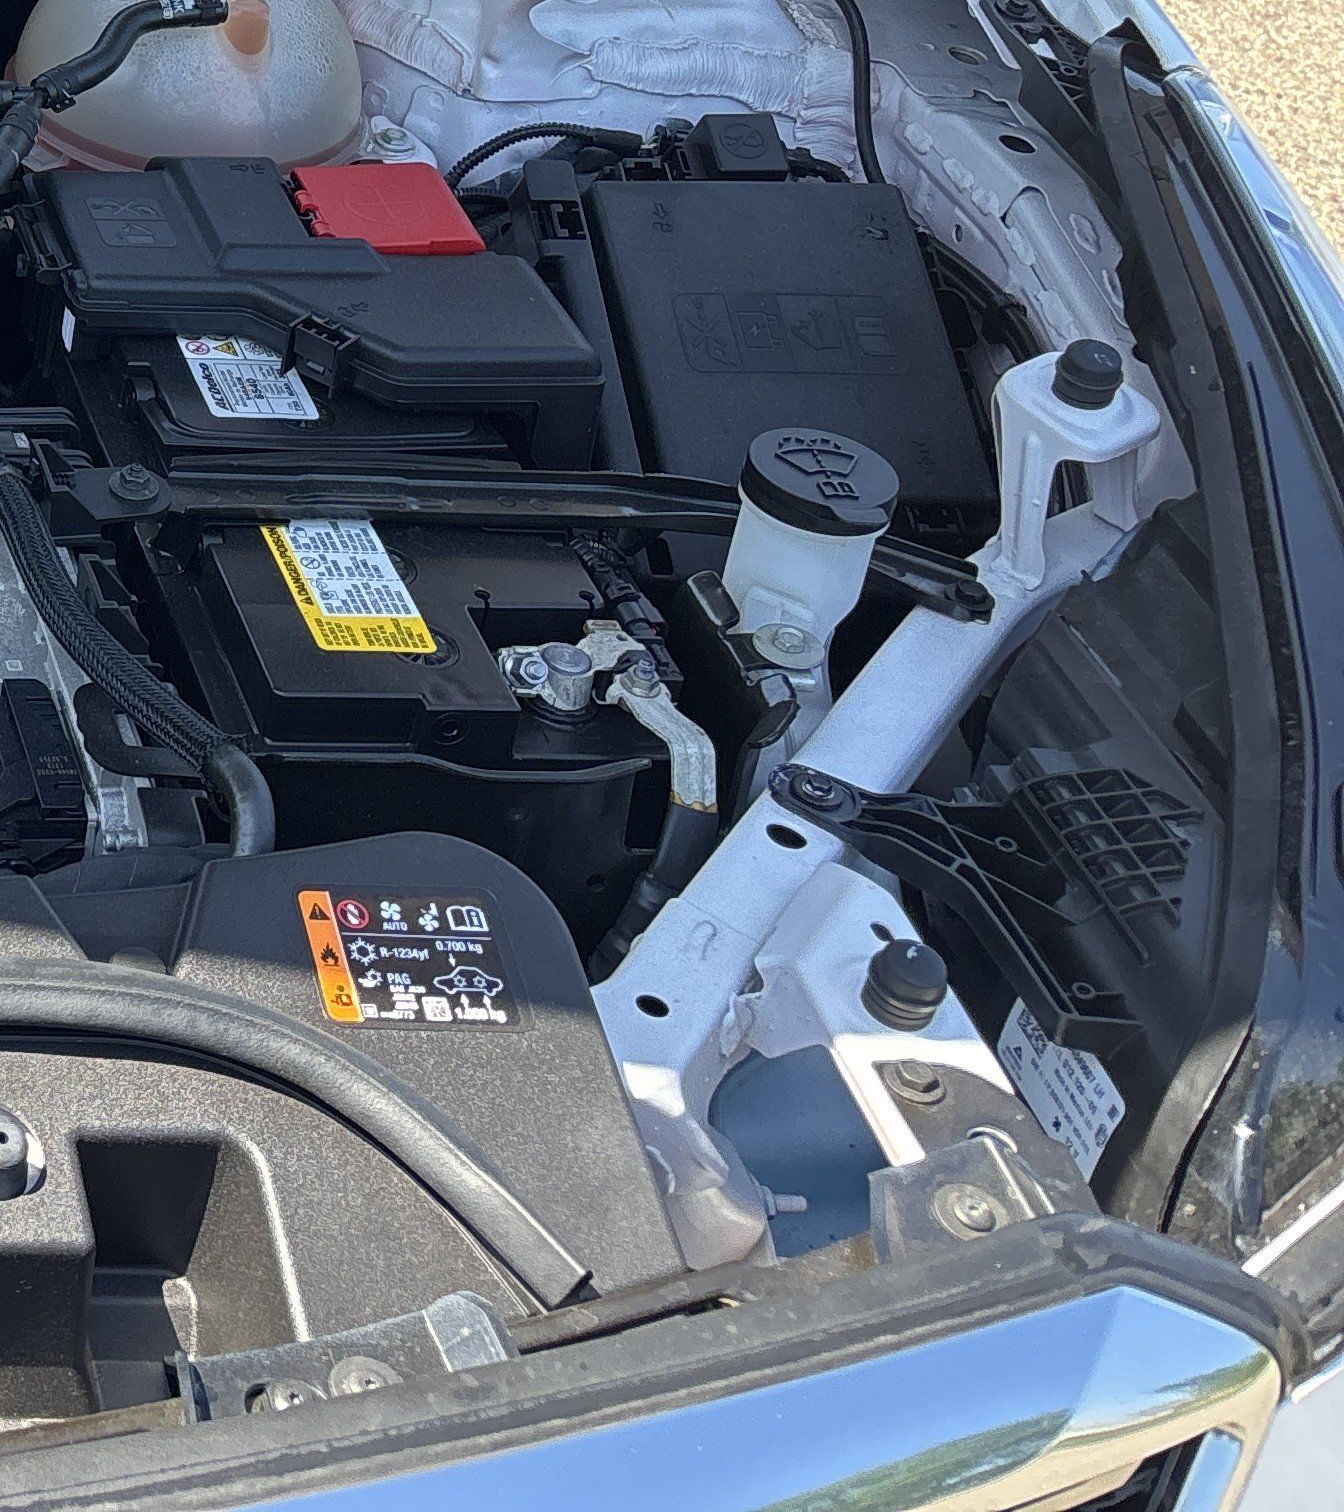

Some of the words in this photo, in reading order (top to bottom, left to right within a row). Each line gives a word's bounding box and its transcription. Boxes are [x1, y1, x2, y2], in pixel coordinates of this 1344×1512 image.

[198, 362, 230, 411] ACDelco
[382, 921, 408, 932] AUTO
[379, 946, 430, 961] R-1234yf
[435, 940, 466, 953] 0.700
[468, 941, 484, 955] kg
[386, 971, 412, 985] PAG
